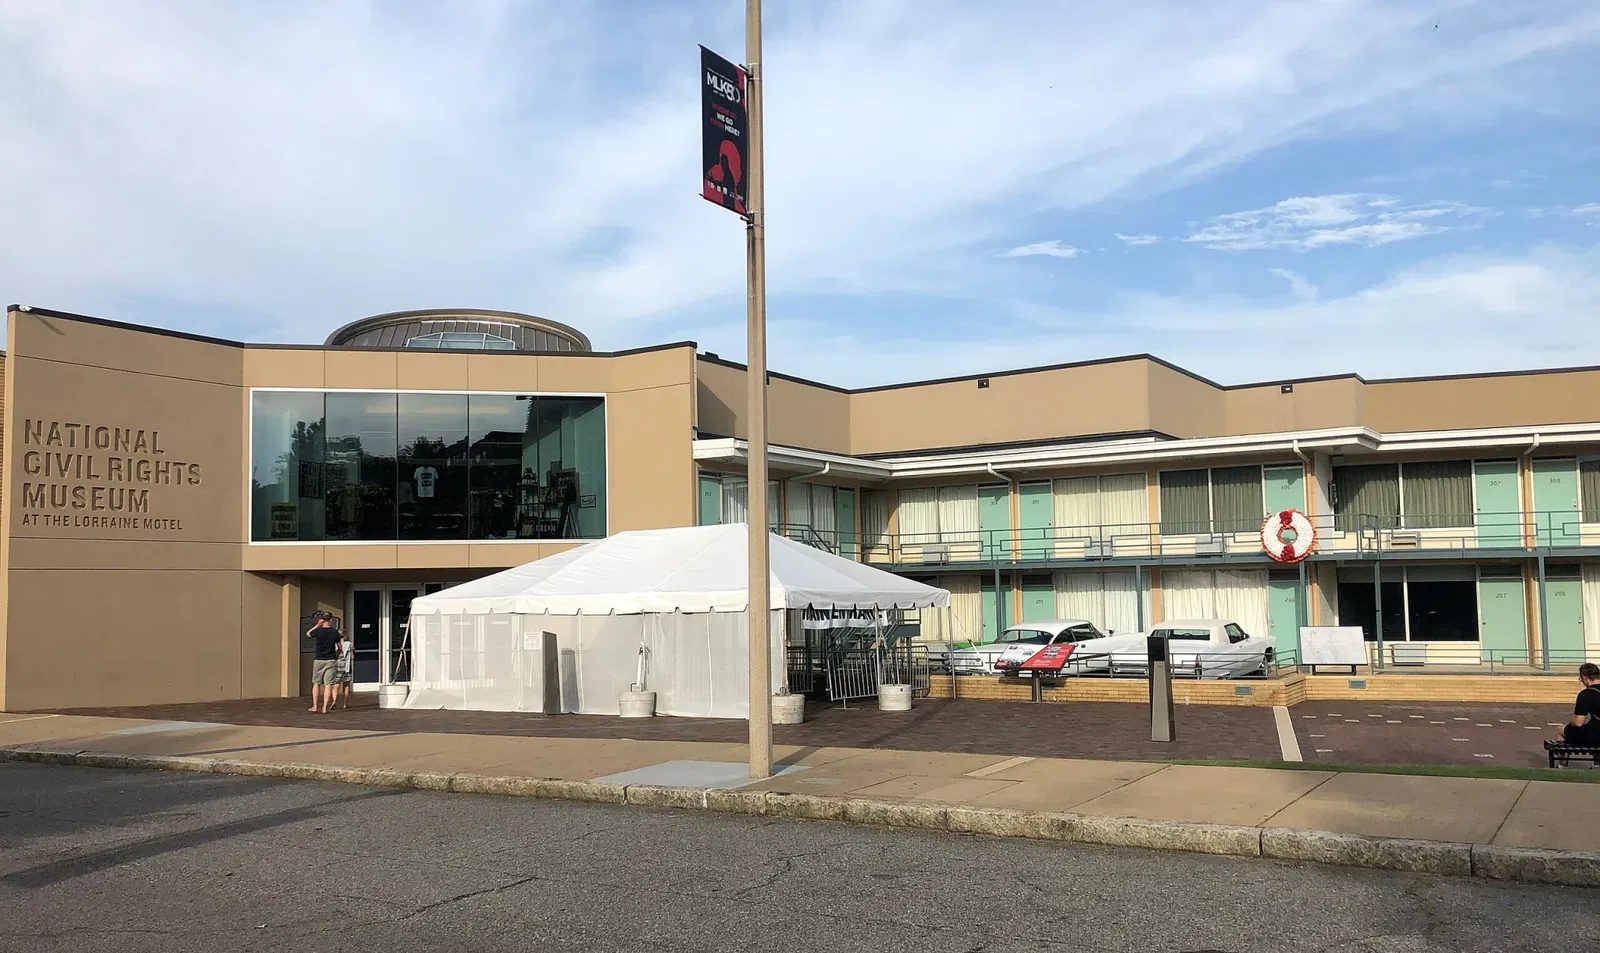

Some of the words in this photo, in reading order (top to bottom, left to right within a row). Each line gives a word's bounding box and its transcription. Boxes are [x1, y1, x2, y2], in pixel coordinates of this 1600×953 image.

[716, 112, 726, 123] WE
[725, 116, 734, 126] GO
[724, 124, 741, 137] HERE?
[24, 418, 165, 455] NATIONAL
[23, 450, 100, 481] CIVIL
[108, 456, 202, 486] RIGHTS
[22, 482, 150, 514] MUSEUM
[22, 513, 40, 526] AT
[44, 514, 70, 528] THE
[74, 515, 139, 529] LORRAINE
[143, 518, 183, 531] MOTEL
